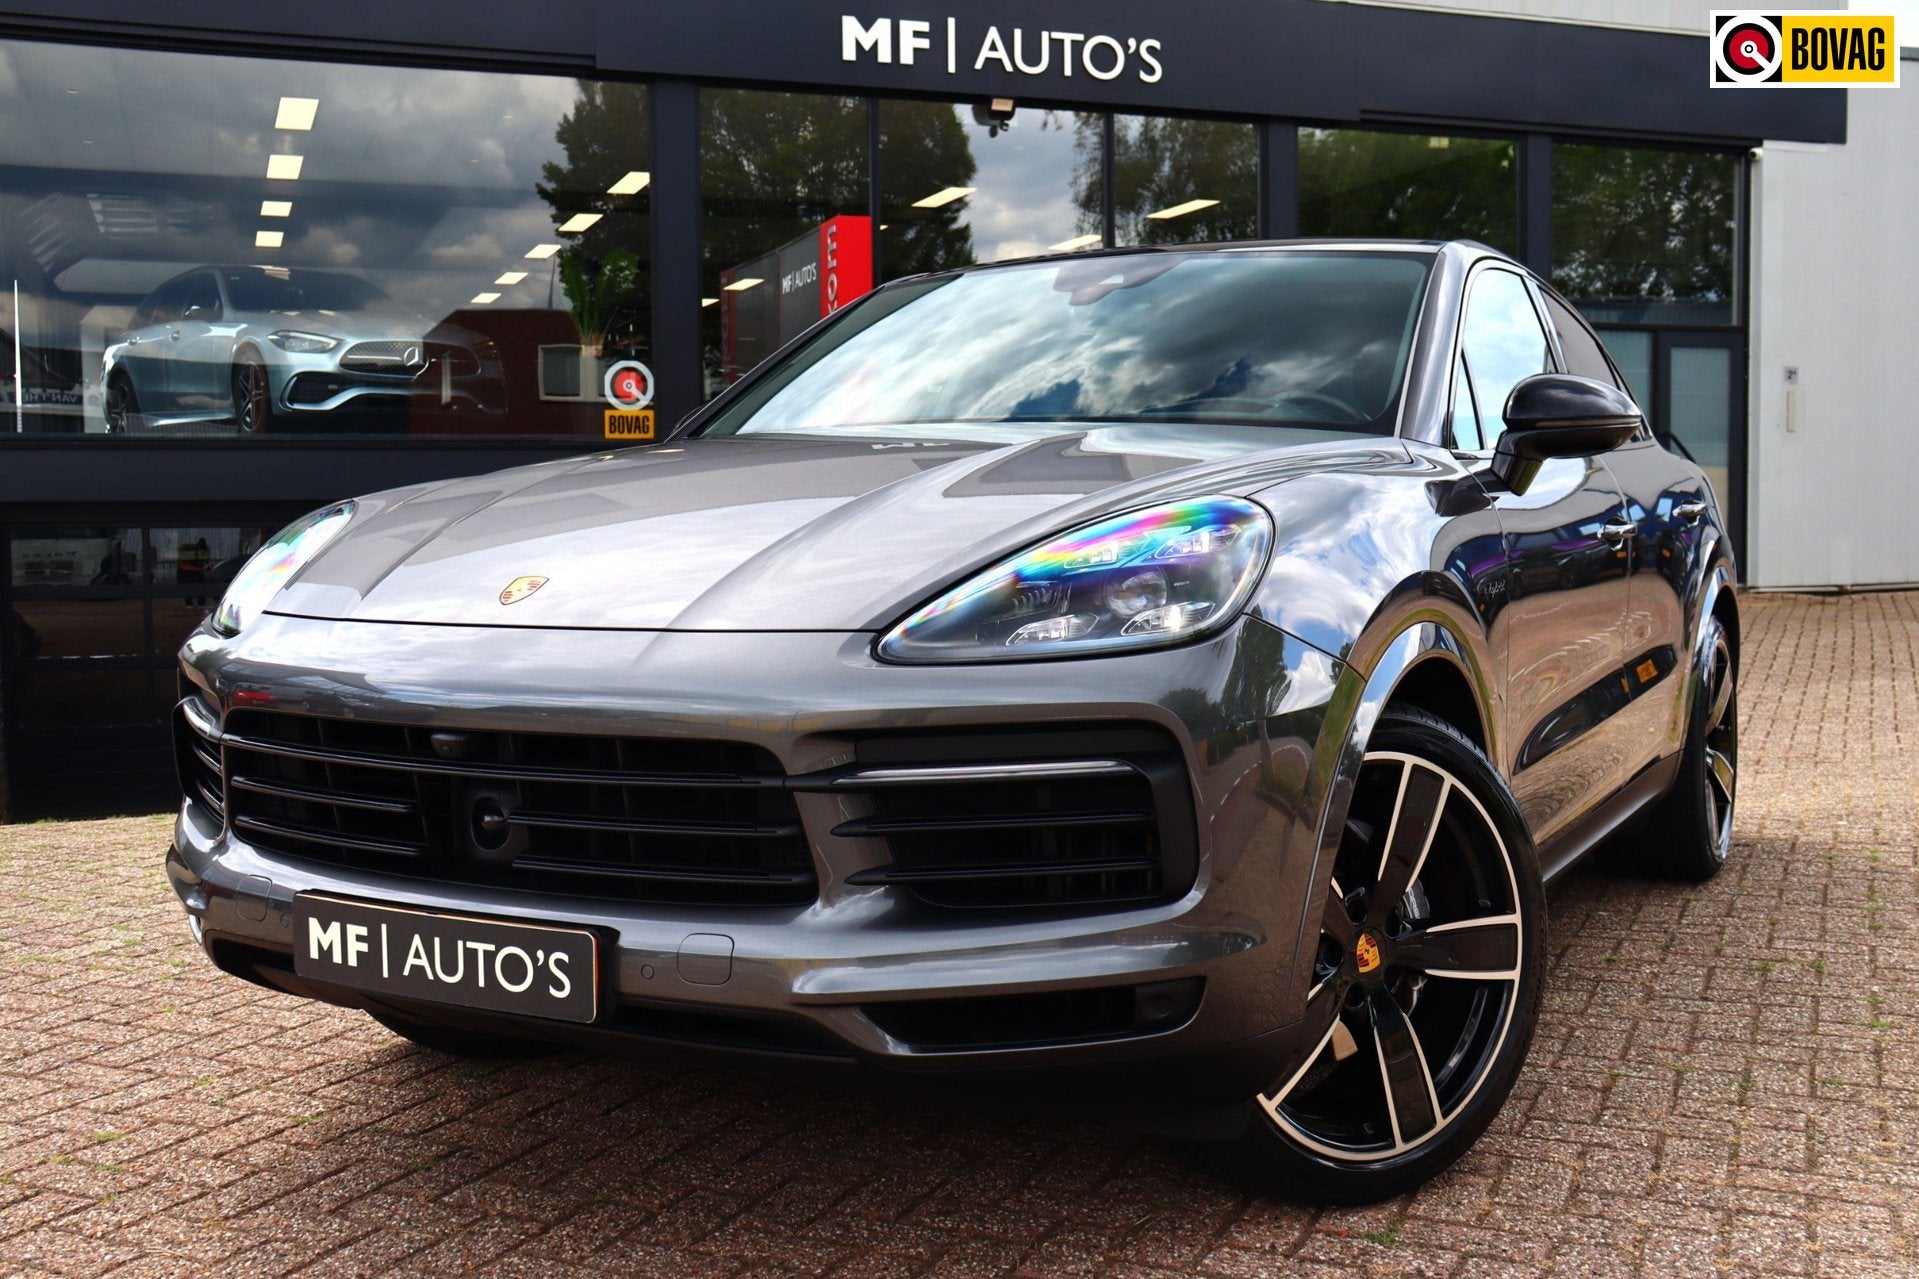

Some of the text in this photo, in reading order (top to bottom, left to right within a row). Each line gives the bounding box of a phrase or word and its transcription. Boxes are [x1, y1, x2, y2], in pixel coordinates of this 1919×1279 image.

[841, 15, 1163, 83] MF AUTO'S
[782, 275, 792, 295] MF
[608, 414, 650, 434] BOVAG
[308, 916, 571, 999] MF AUTO'S
